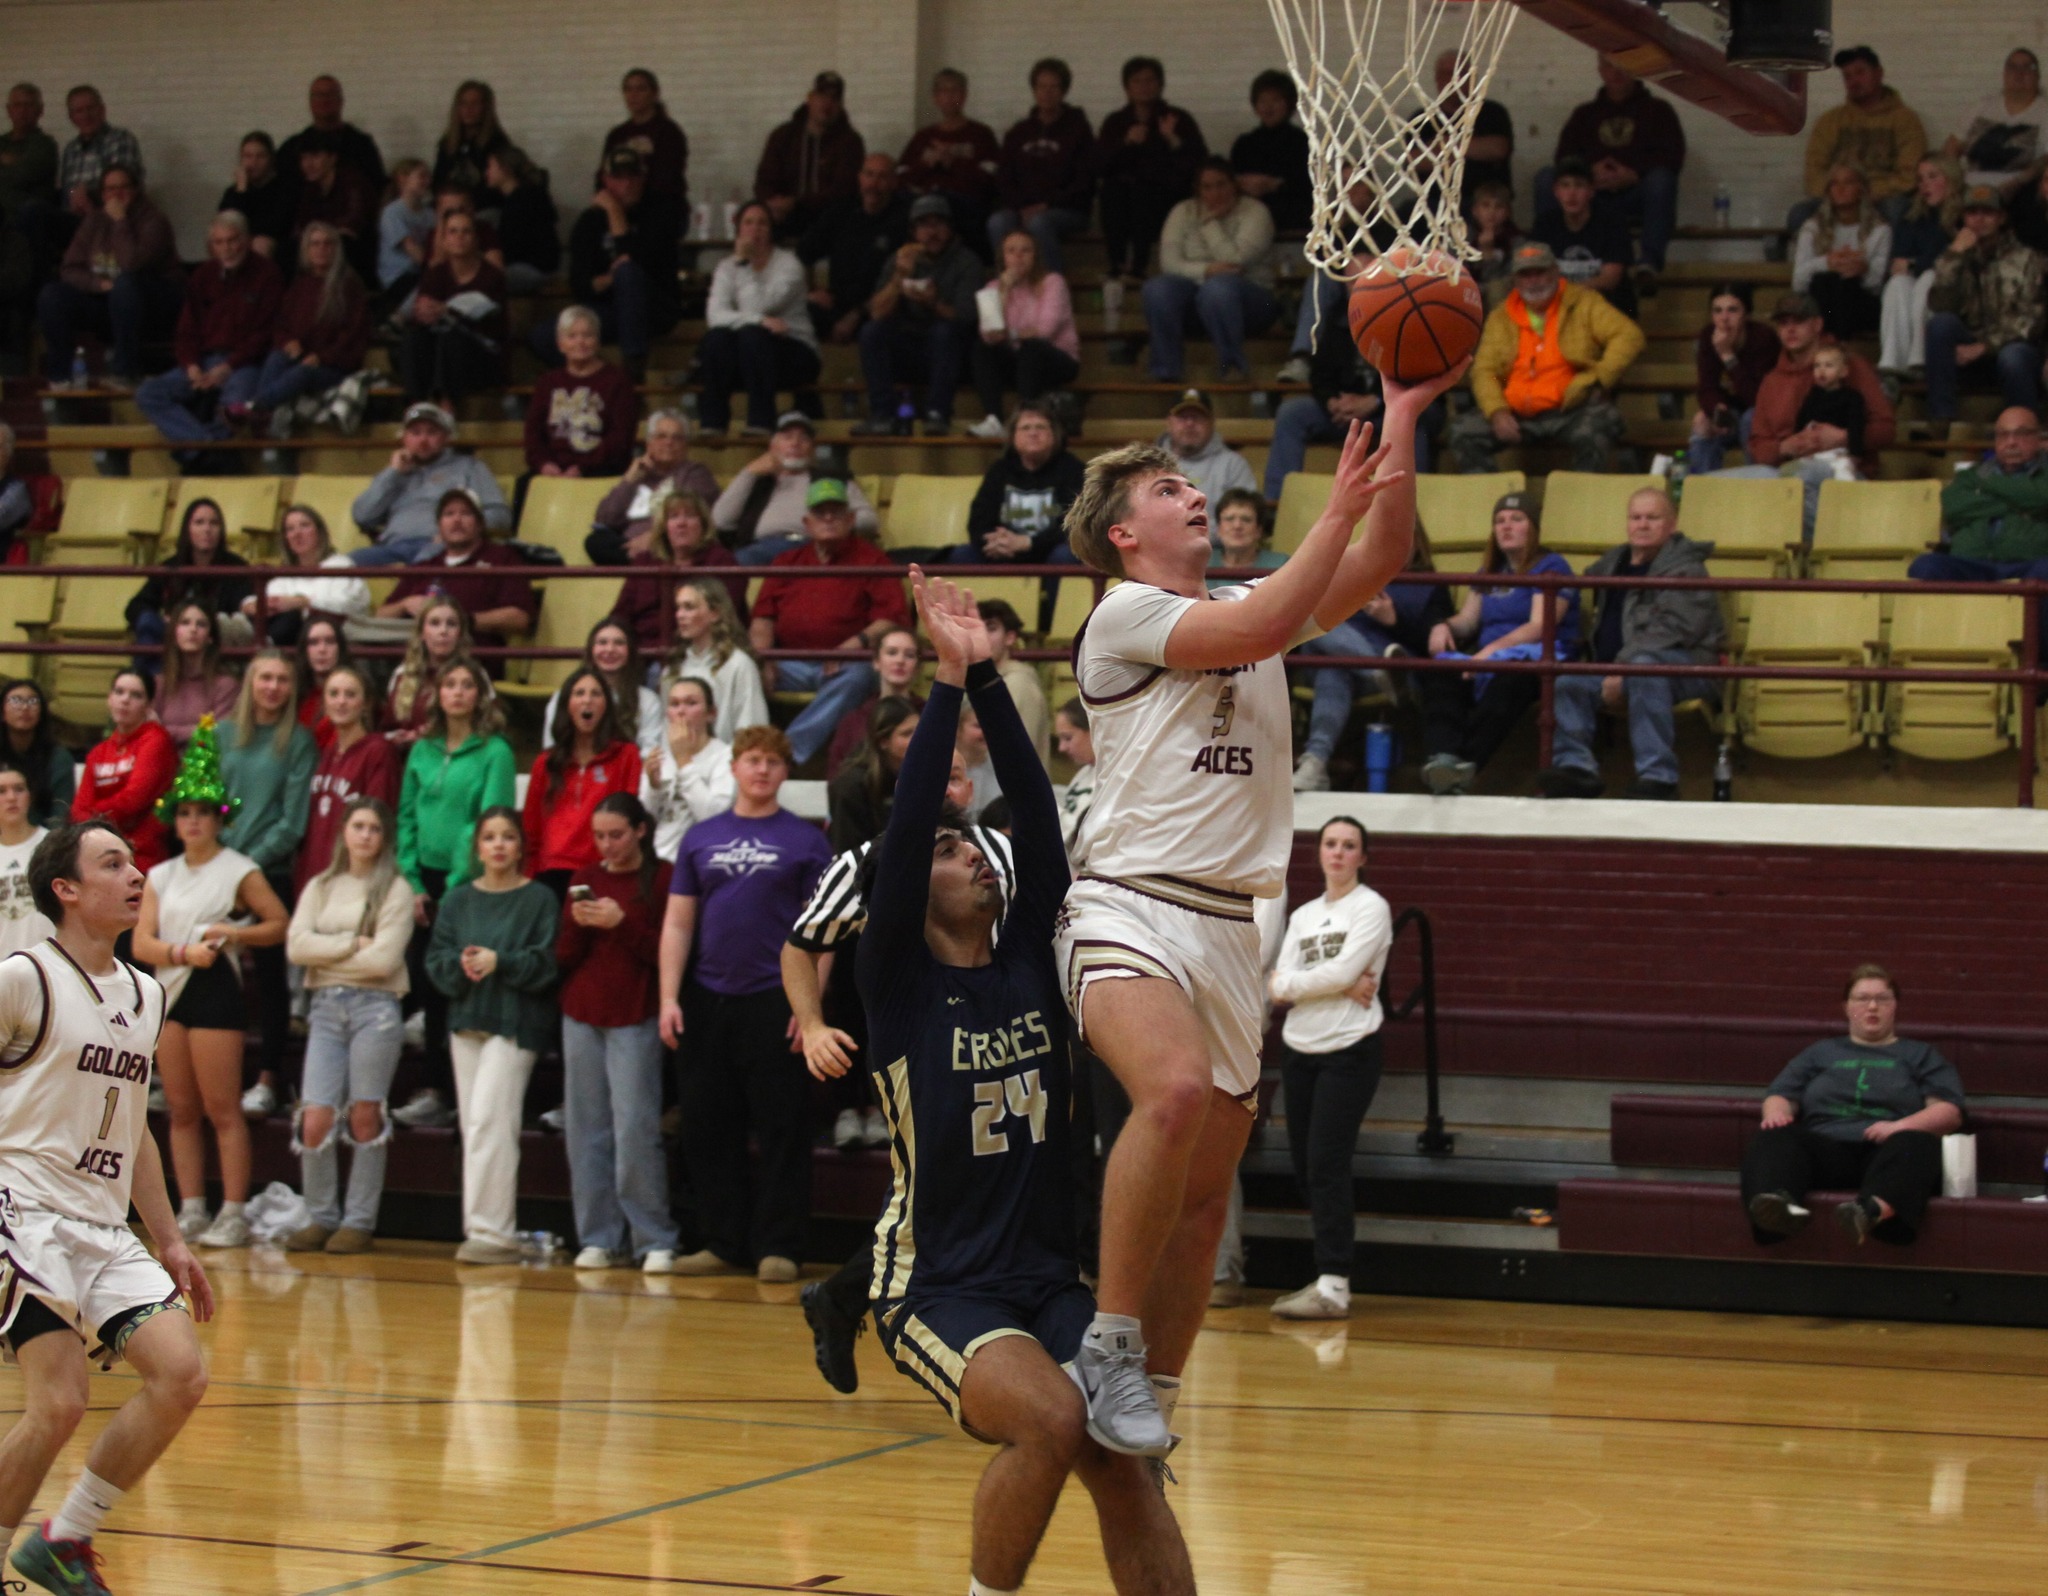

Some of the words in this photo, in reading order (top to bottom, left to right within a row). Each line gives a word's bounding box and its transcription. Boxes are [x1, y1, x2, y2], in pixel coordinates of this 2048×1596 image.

[1190, 745, 1253, 776] ACES
[77, 1043, 149, 1084] GOLDEN
[952, 1010, 1051, 1070] EAGLES
[98, 1086, 119, 1140] 1
[971, 1068, 1048, 1156] 24
[75, 1146, 123, 1179] ACES
